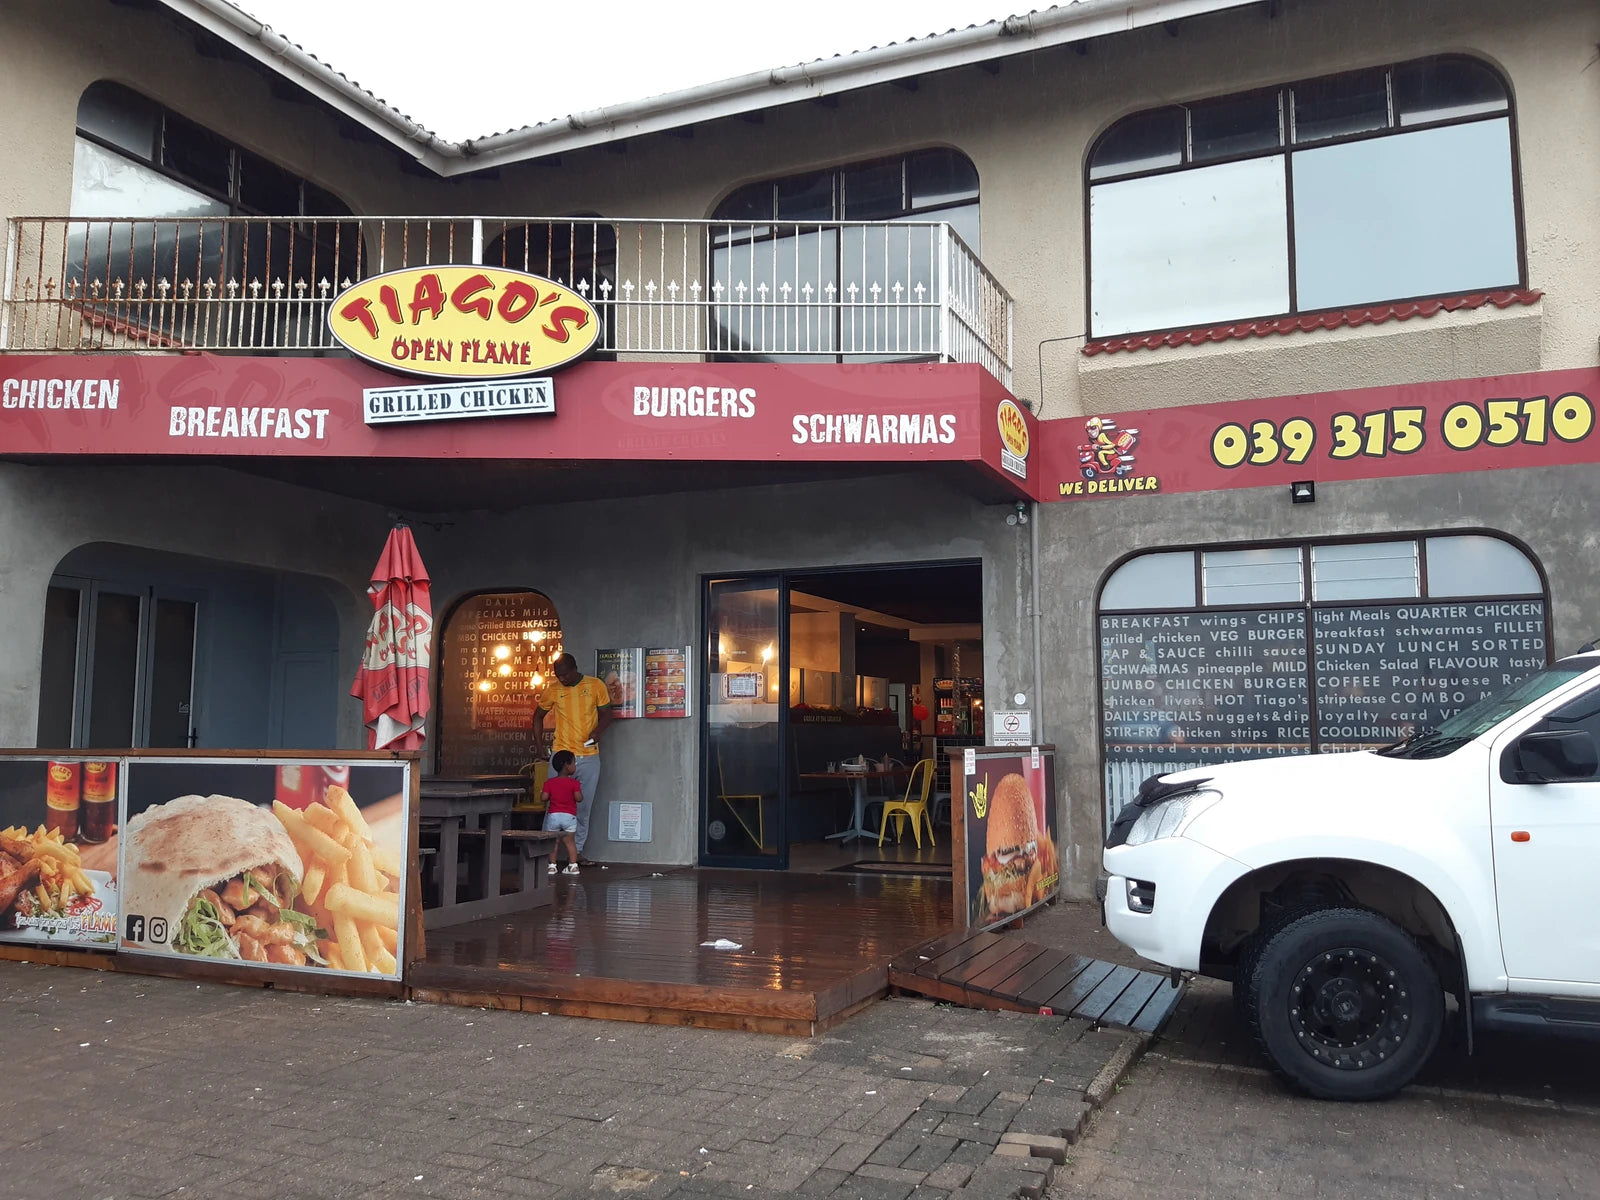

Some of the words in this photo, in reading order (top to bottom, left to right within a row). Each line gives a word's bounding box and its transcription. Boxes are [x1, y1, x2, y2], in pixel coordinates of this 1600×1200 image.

[340, 273, 589, 344] TIAGO'S
[391, 335, 454, 363] OPEN
[461, 338, 532, 366] FLAME
[1, 377, 120, 411] CHICKEN
[369, 391, 452, 415] GRILLED
[460, 386, 548, 411] CHICKEN
[633, 386, 757, 419] BURGERS
[169, 405, 330, 440] BREAKFAST
[792, 413, 957, 445] SCHWARMAS
[1000, 406, 1027, 446] TIAGO'S
[1212, 418, 1315, 468] 039
[1330, 408, 1426, 459] 315
[1442, 393, 1595, 451] 0510
[1059, 481, 1084, 495] WE
[1088, 476, 1158, 494] DELIVER
[485, 598, 525, 606] DAILY
[522, 608, 549, 617] Mild
[1314, 611, 1345, 625] light
[1350, 609, 1391, 621] Meals
[1396, 606, 1468, 620] QUARTER
[1474, 603, 1542, 618] CHICKEN
[478, 621, 504, 631] Grilled
[506, 619, 558, 630] BREAKFASTS
[1102, 616, 1190, 629] BREAKFAST
[1200, 616, 1247, 629] wings
[1257, 612, 1305, 625] CHIPS
[481, 632, 519, 641] CHICKEN
[522, 630, 563, 640] BGERS
[1102, 633, 1143, 646] grilled
[1152, 632, 1201, 644] chicken
[1210, 630, 1239, 642] VEG
[1248, 628, 1305, 641] BURGER
[1315, 626, 1386, 639] breakfast
[1395, 624, 1484, 637] schwarmas
[1494, 620, 1543, 634] FILLET
[1103, 649, 1129, 660] PAP
[1139, 648, 1148, 659] &
[1158, 647, 1206, 659] SAUCE
[1215, 646, 1253, 658] chilli
[1263, 647, 1306, 657] sauce
[1315, 642, 1386, 655] SUNDAY
[1399, 640, 1459, 653] LUNCH
[1471, 638, 1544, 651] SORTED
[1103, 663, 1189, 675] SCHWARMAS
[1197, 662, 1264, 676] pineapple
[1273, 661, 1307, 673] MILD
[1316, 659, 1370, 671] Chicken
[1379, 658, 1419, 670] Salad
[1429, 656, 1499, 669] FLAVOUR
[1509, 656, 1545, 671] tasty
[1103, 679, 1155, 691] JUMBO
[1165, 678, 1234, 690] CHICKEN
[1244, 677, 1307, 689] BURGER
[1317, 675, 1381, 688] COFFEE
[1392, 673, 1490, 689] Portuguese
[487, 694, 529, 703] LOYALTY
[1104, 694, 1155, 706] chicken
[1165, 694, 1204, 706] livers
[1214, 694, 1245, 705] HOT
[1254, 694, 1308, 708] Tiago's
[1391, 692, 1465, 704] COMBO
[1104, 710, 1140, 721] DAILY
[1143, 710, 1202, 721] SPECIALS
[1318, 709, 1379, 723] loyalty
[1391, 709, 1428, 720] card
[1104, 727, 1162, 738] STIR-FRY
[1171, 727, 1221, 738] chicken
[1231, 727, 1268, 741] strips
[1277, 727, 1310, 738] RICE
[1319, 726, 1416, 738] COOLDRINKS
[1105, 743, 1177, 754] toasted
[1190, 743, 1310, 755] sandwiches
[1105, 758, 1155, 769] kiddie
